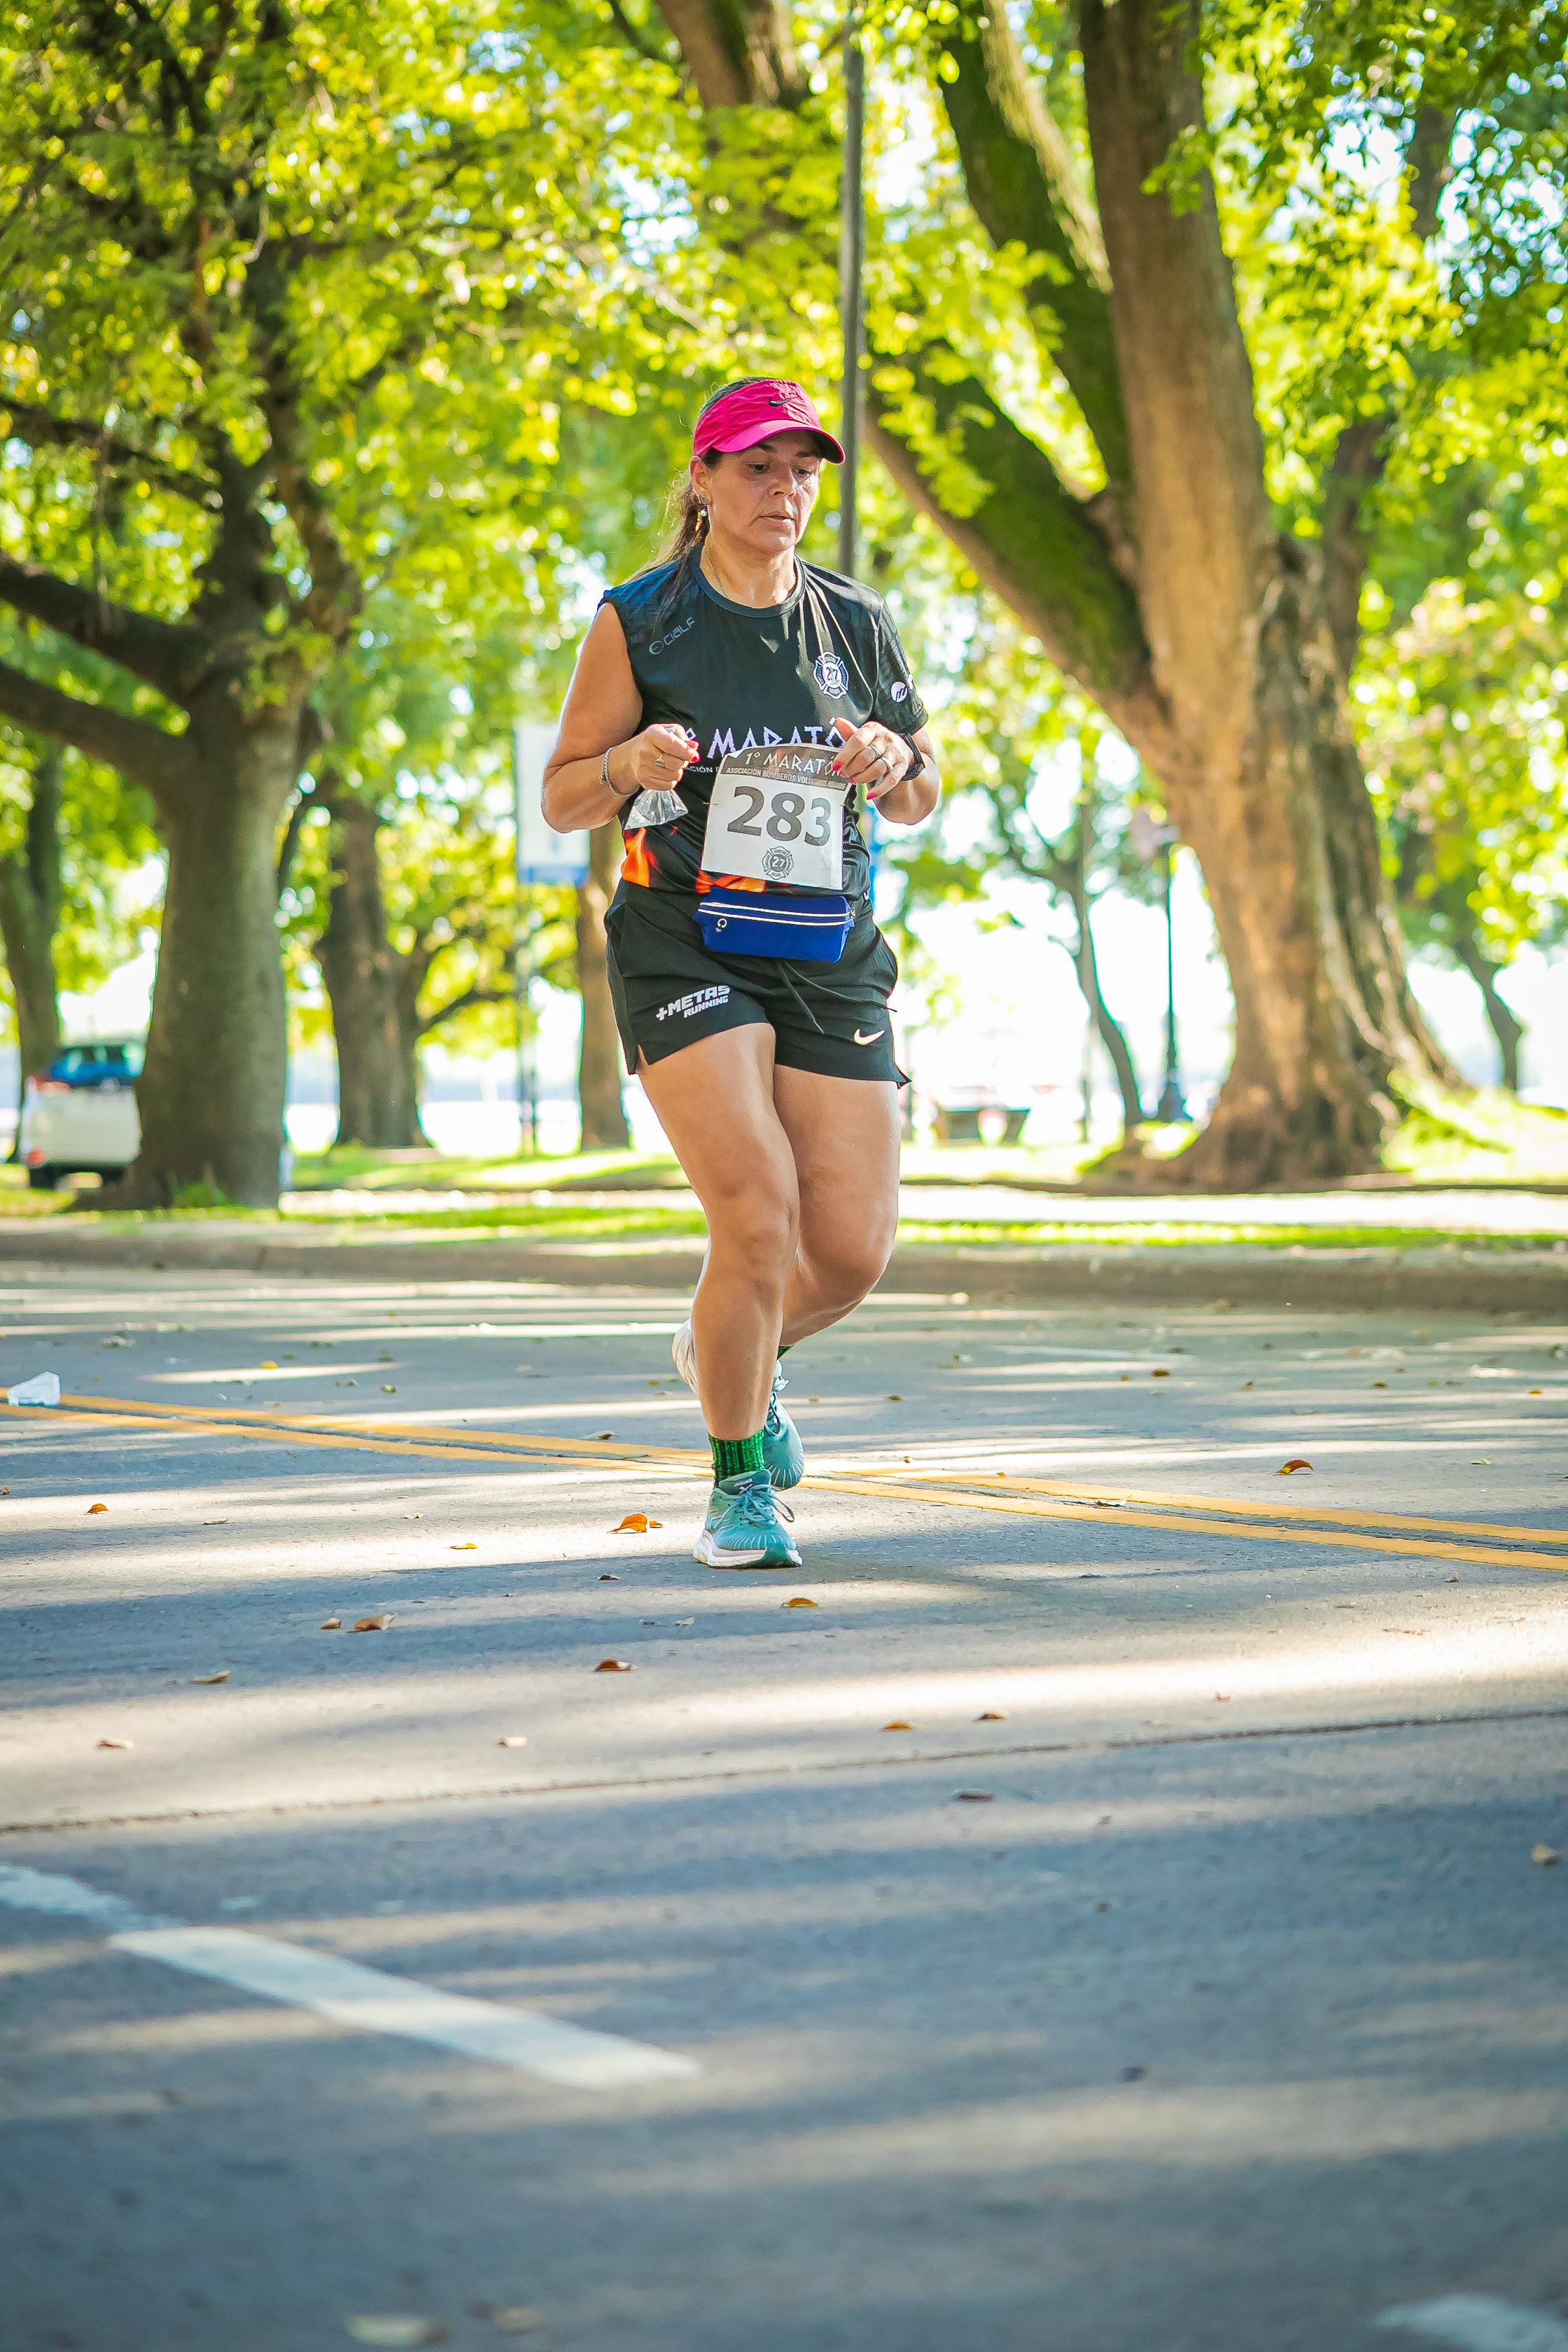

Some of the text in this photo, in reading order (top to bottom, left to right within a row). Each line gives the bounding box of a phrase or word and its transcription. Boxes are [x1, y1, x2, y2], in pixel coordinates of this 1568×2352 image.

[707, 716, 846, 759] MARATÓ
[762, 769, 797, 782] BOMBEROS
[727, 785, 832, 846] 283
[771, 855, 786, 869] 27
[683, 995, 729, 1018] RUNNING
